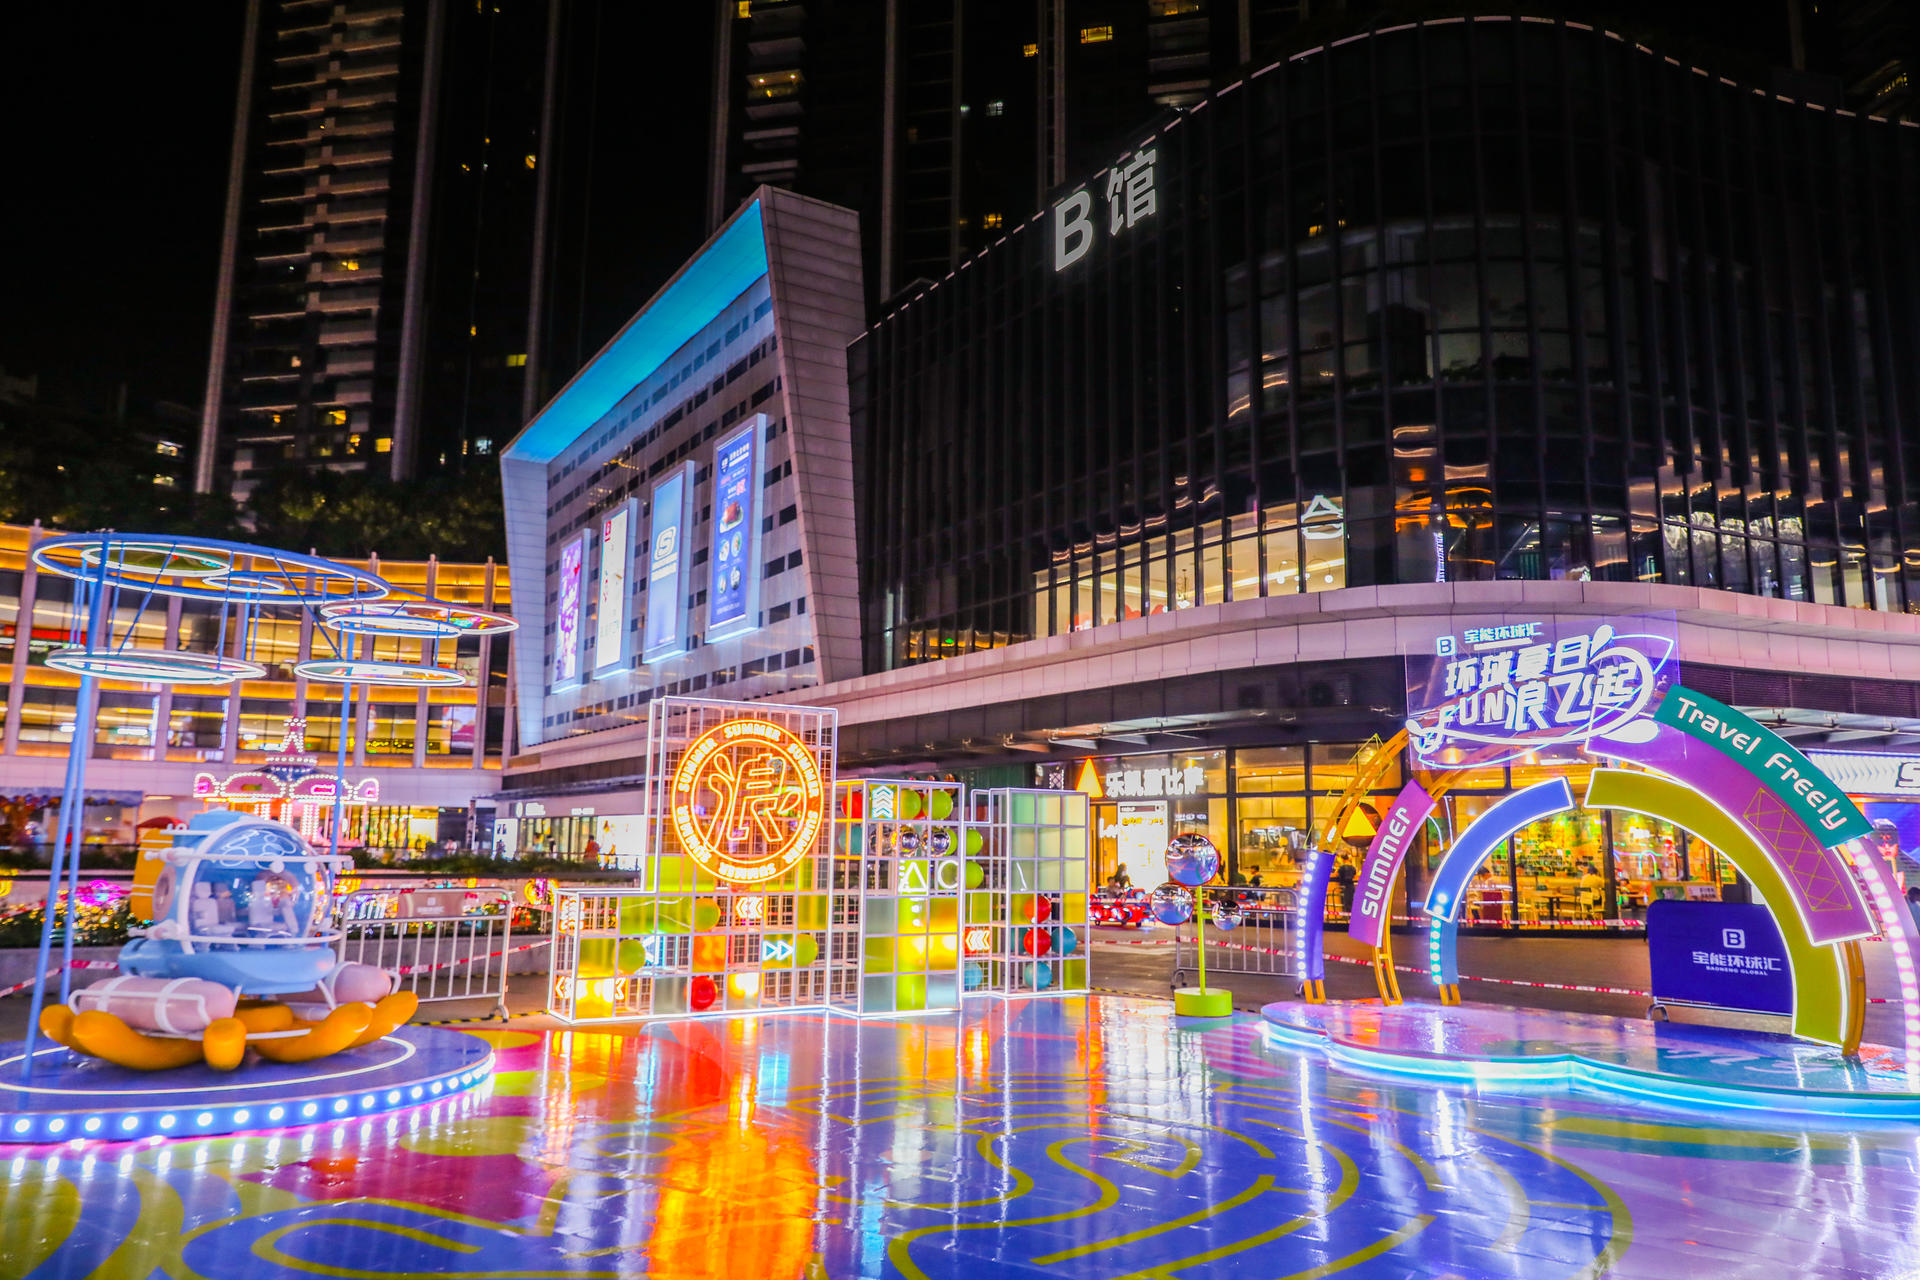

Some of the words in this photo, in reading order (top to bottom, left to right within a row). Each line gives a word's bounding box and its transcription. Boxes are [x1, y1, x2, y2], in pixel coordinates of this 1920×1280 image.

[1464, 622, 1544, 644] 宝能环球汇
[1445, 634, 1591, 697] 环球夏日
[724, 723, 781, 742] SUMMER
[678, 738, 718, 793] SUMMER
[787, 743, 820, 798] SUMMER
[1678, 697, 1762, 755] Travel
[1764, 753, 1848, 830] Freely
[719, 862, 777, 880] SUMMER
[1692, 951, 1782, 971] 宝能环球汇
